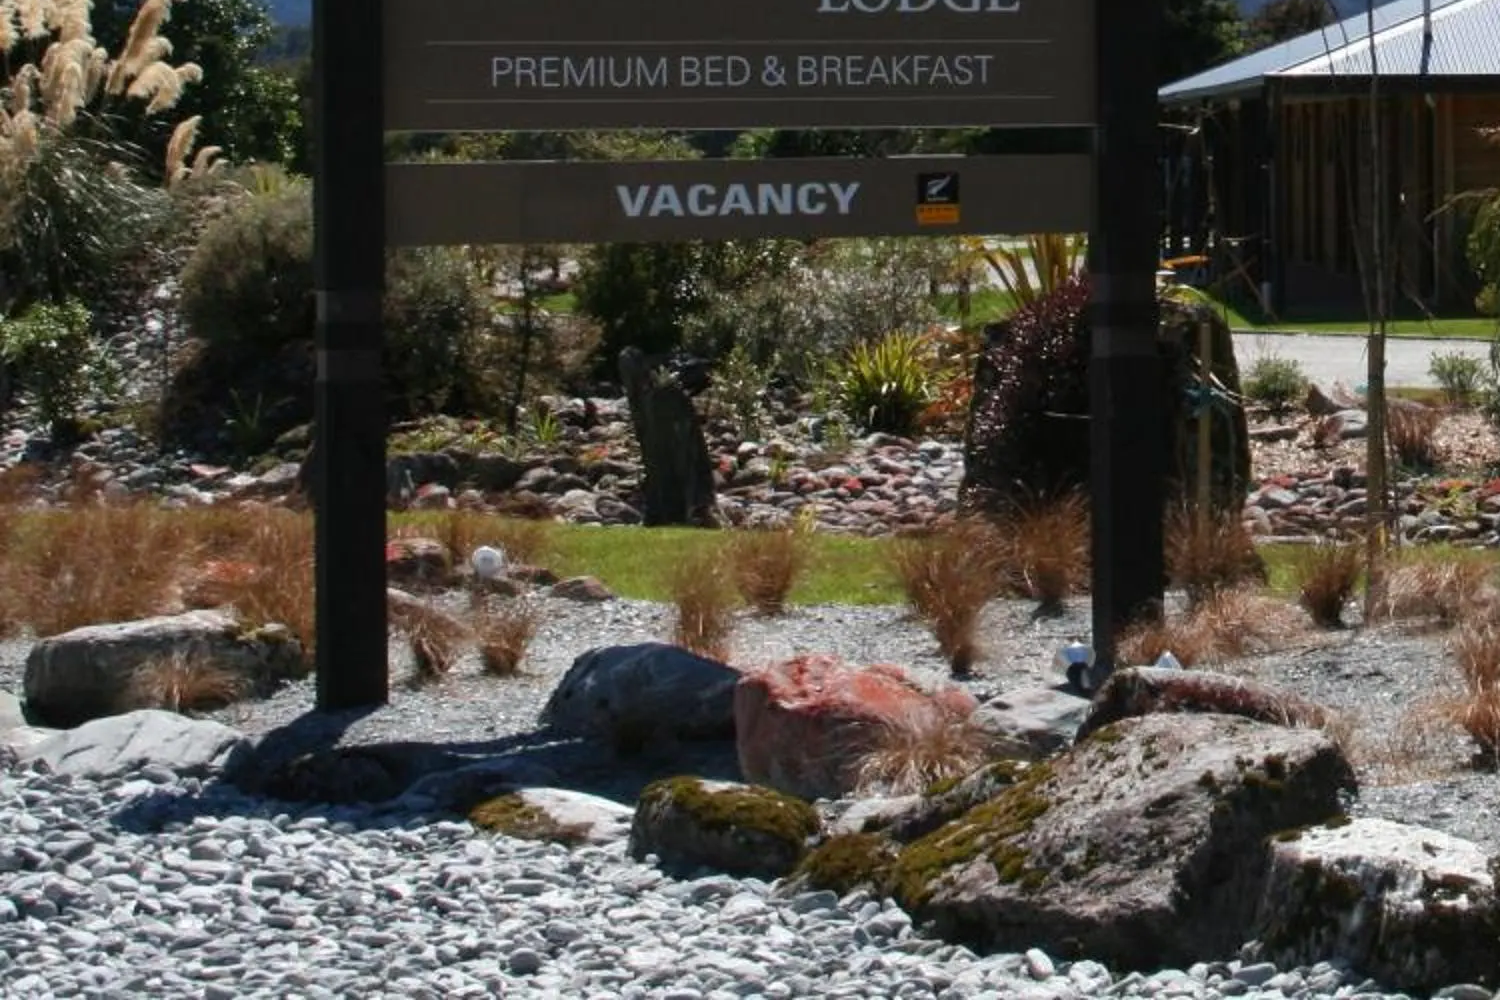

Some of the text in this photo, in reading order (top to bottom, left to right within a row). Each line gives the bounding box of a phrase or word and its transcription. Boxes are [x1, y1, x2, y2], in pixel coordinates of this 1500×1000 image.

[492, 55, 992, 87] PREMIUM BED & BREAKFAST
[617, 183, 859, 216] VACANCY
